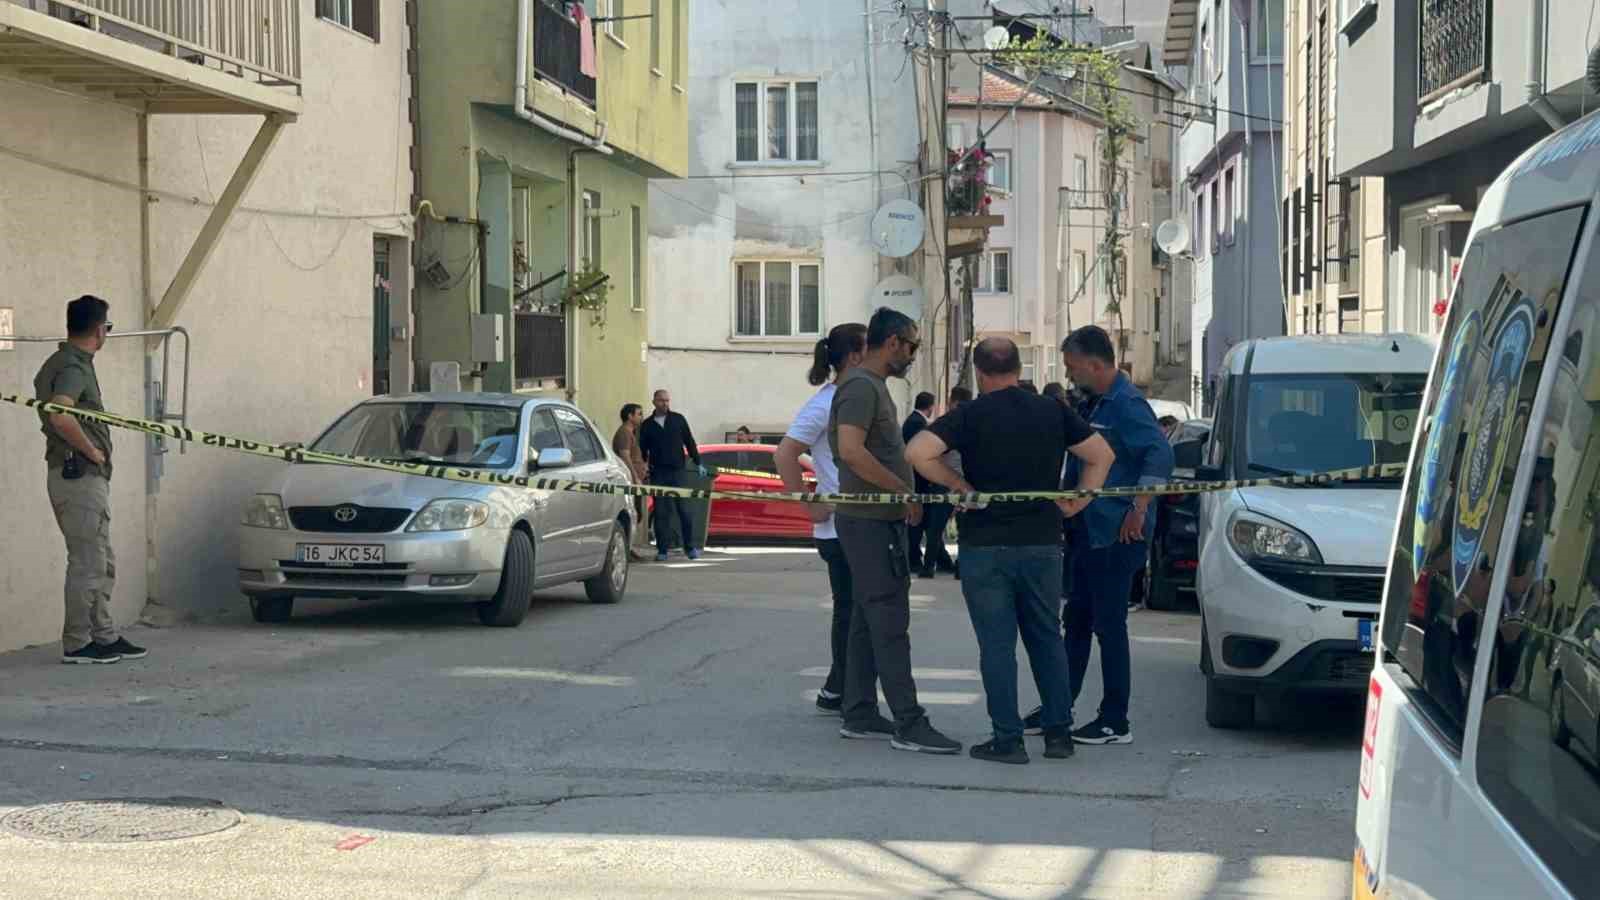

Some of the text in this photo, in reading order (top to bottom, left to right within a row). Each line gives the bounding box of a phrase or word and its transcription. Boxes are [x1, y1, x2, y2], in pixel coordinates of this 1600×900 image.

[305, 546, 381, 561] 16 JKC 54
